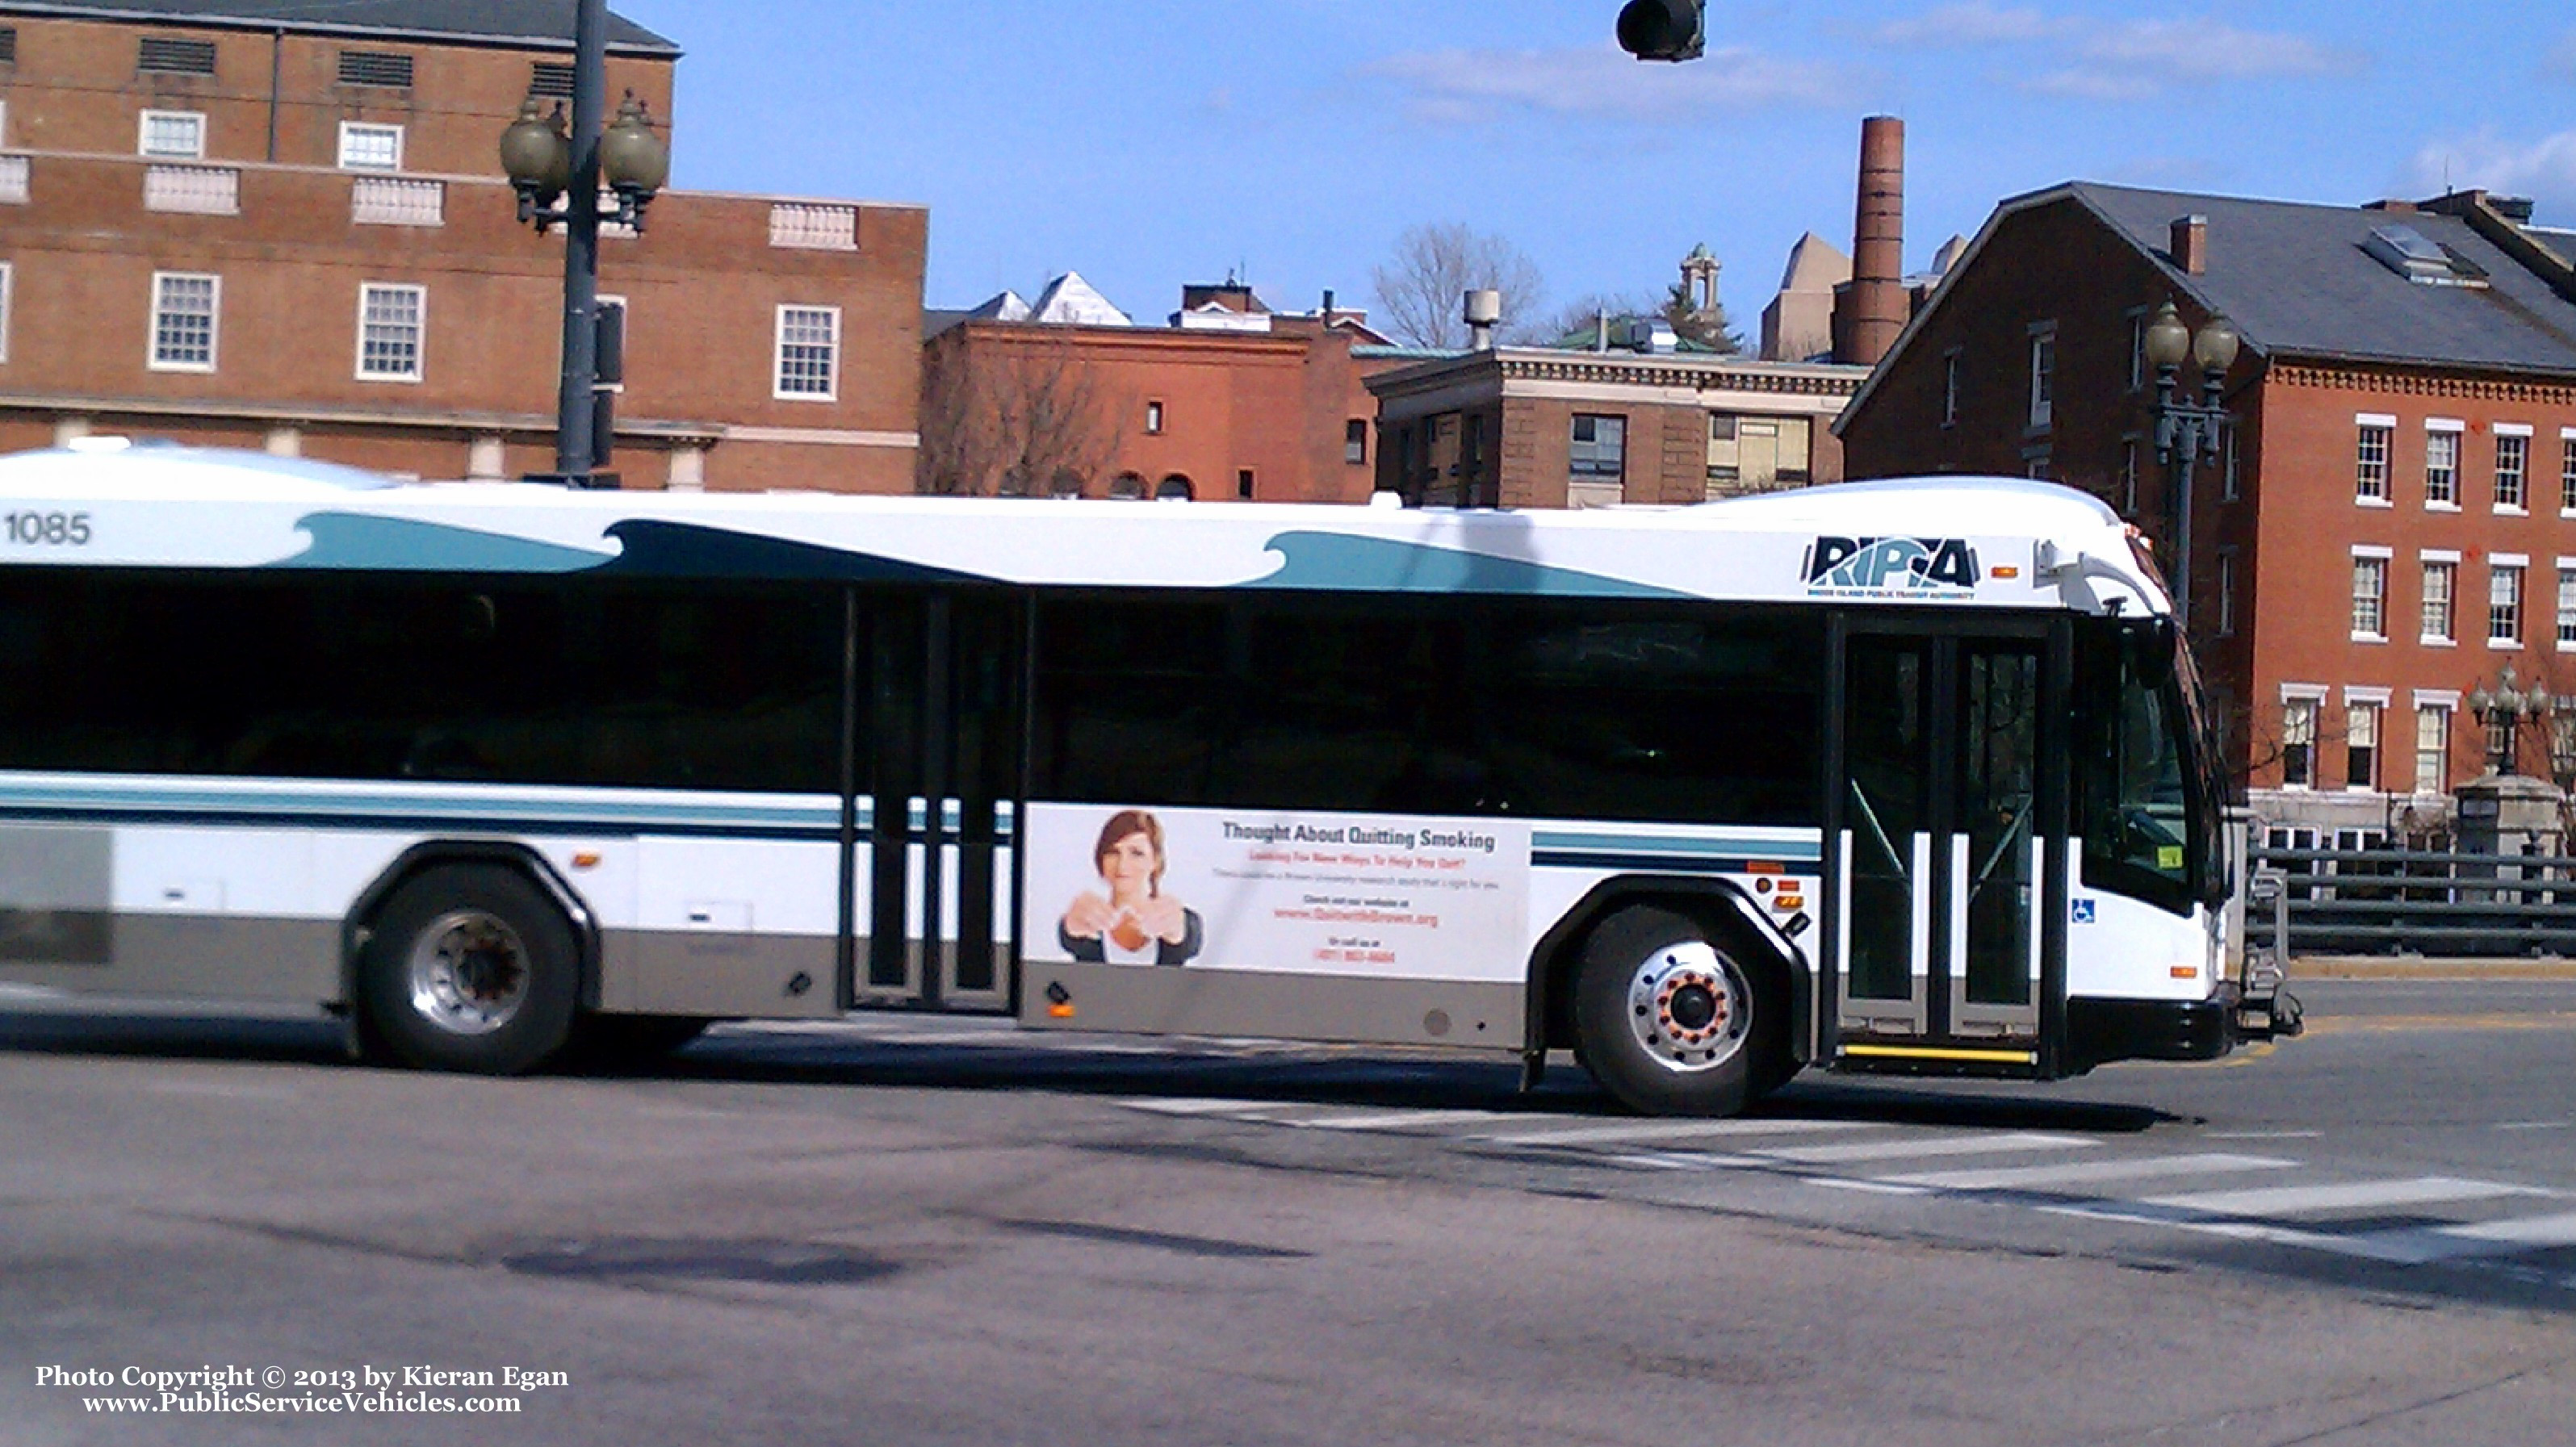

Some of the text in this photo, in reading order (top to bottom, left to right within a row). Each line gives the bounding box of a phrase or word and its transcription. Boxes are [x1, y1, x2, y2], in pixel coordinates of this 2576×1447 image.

[5, 512, 91, 546] 1085
[1223, 821, 1496, 854] Thought About Quitting Smoking
